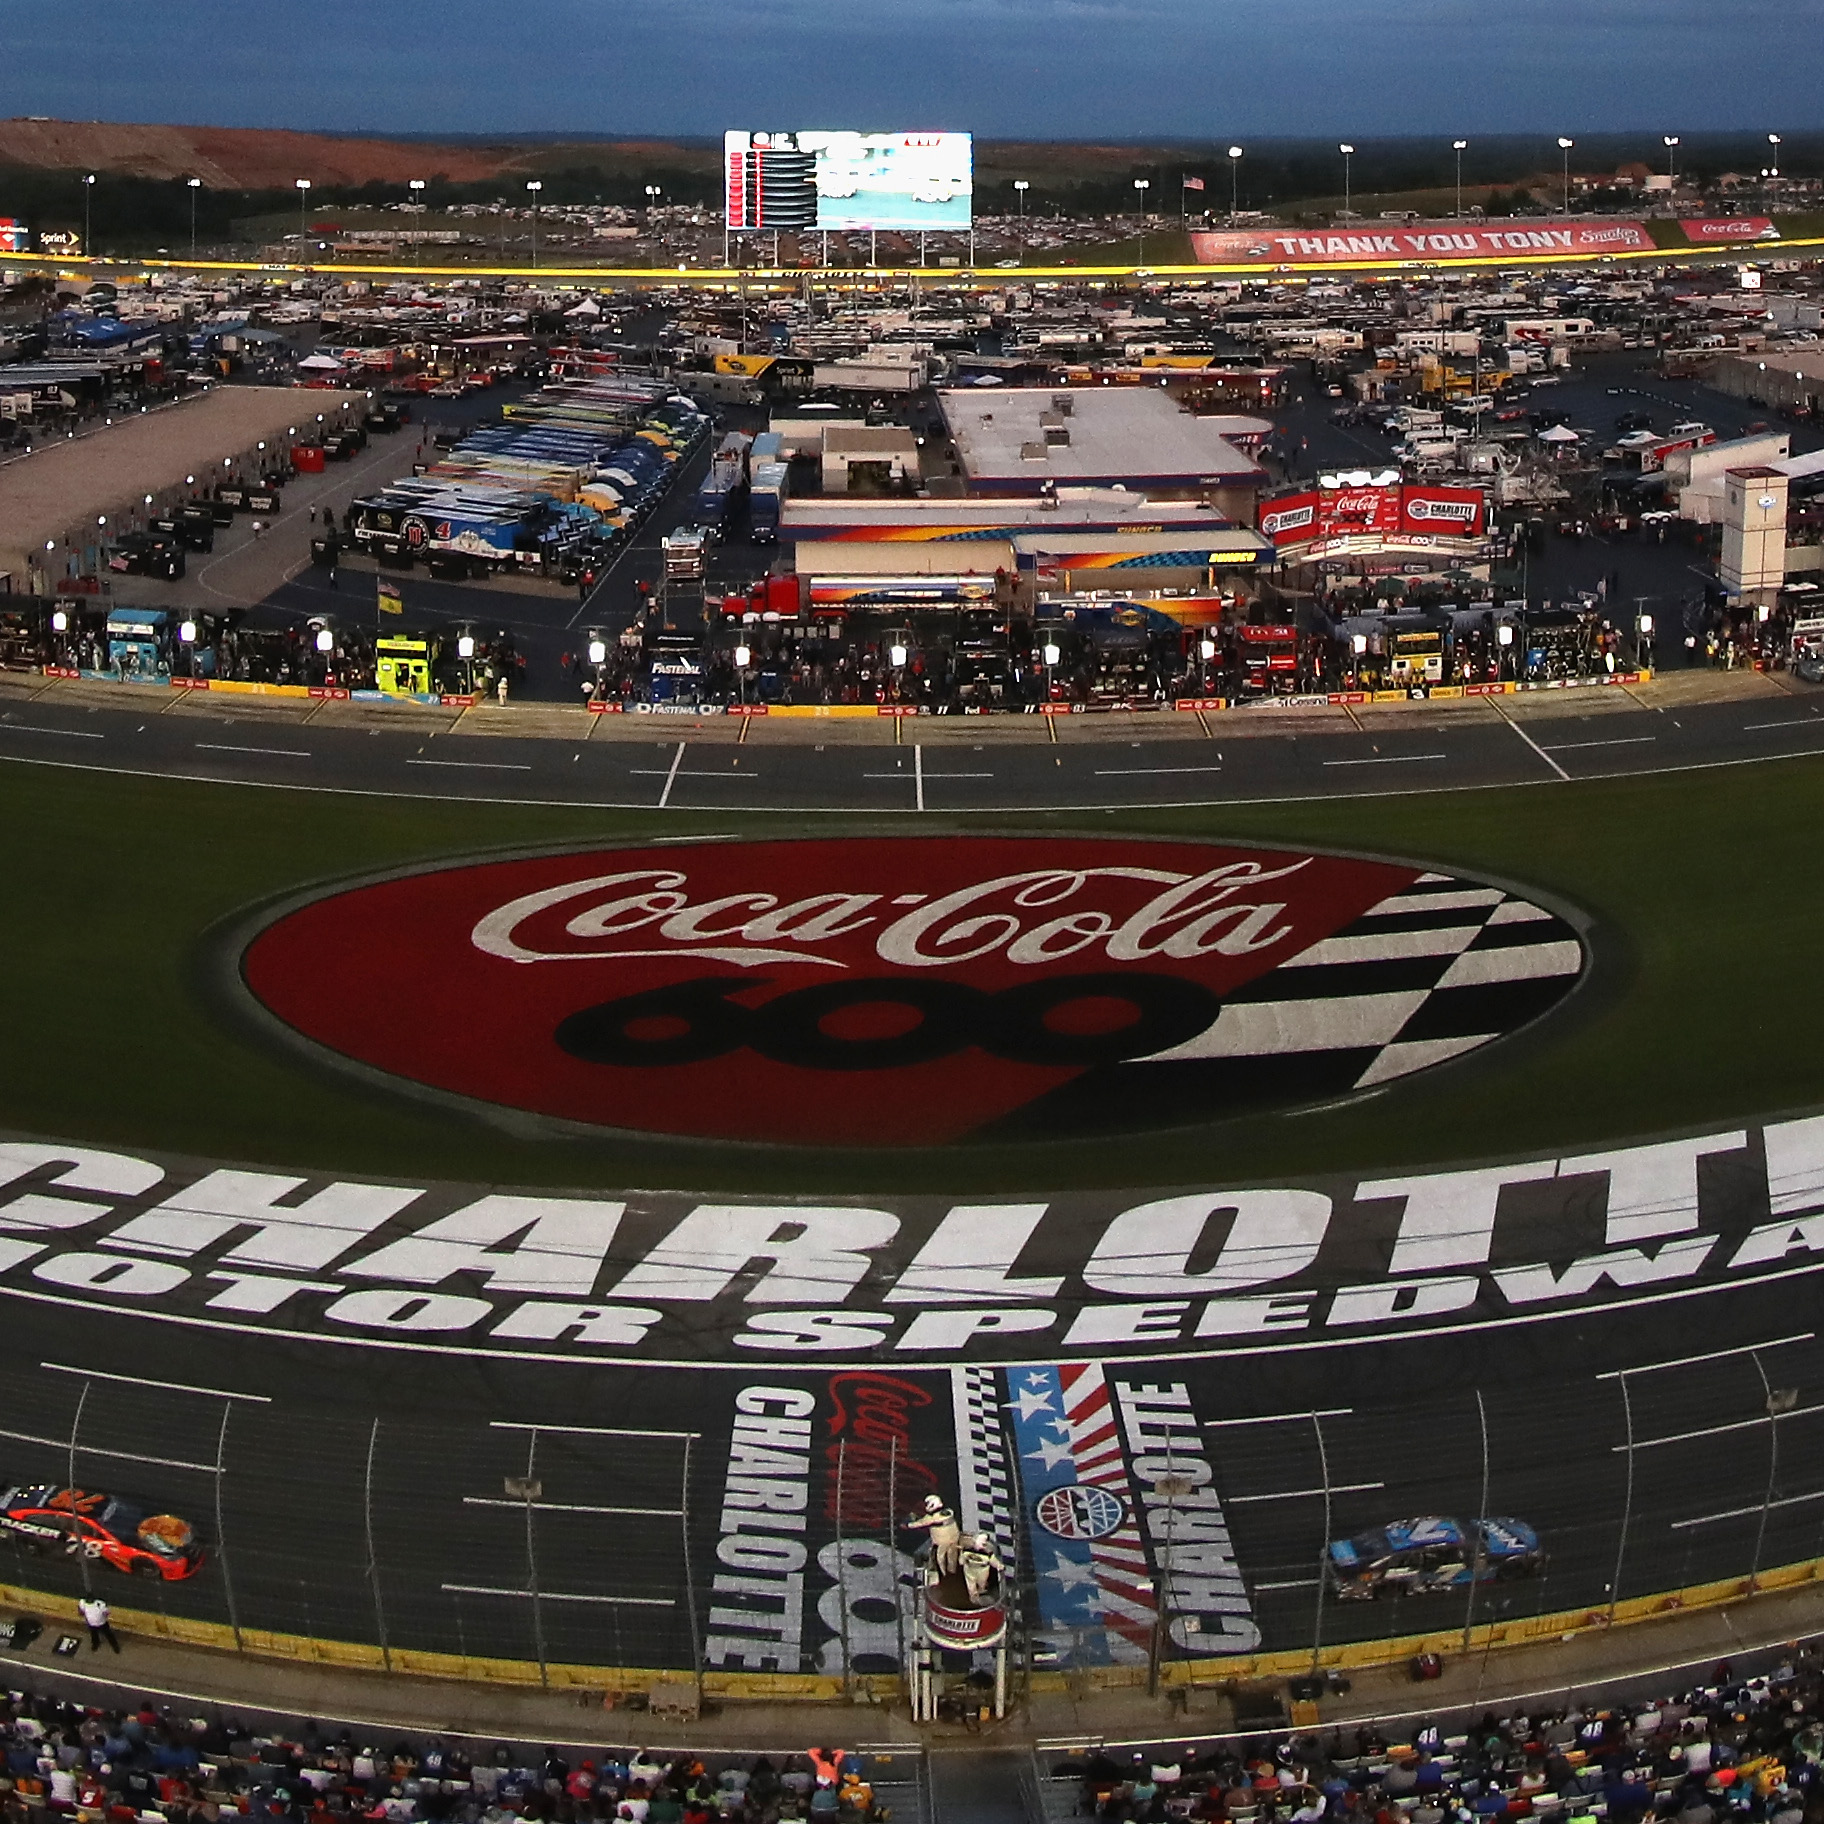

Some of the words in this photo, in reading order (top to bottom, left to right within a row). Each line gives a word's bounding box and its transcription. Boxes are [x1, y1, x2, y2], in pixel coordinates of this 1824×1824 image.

[1701, 221, 1753, 235] Coca-Cola
[40, 232, 67, 244] Sprint
[1276, 234, 1399, 257] THANK
[1404, 232, 1479, 254] YOU
[1480, 230, 1574, 250] TONY
[1337, 495, 1380, 512] Coca-Cola
[436, 522, 451, 539] 4
[1209, 552, 1257, 563] SUNOCO
[1411, 688, 1425, 699] 3
[652, 704, 696, 715] FASTENAL
[470, 858, 1314, 968] Coca-Cola
[554, 972, 1221, 1072] 600
[824, 1371, 939, 1527] Coca-Cola
[1113, 1380, 1263, 1653] CHARLOTTE
[705, 1385, 816, 1673] CHARLOTTE
[937, 1616, 977, 1630] CHARLOTTE
[59, 1637, 77, 1653] F
[1418, 1726, 1438, 1745] 48
[1582, 1721, 1603, 1739] 48
